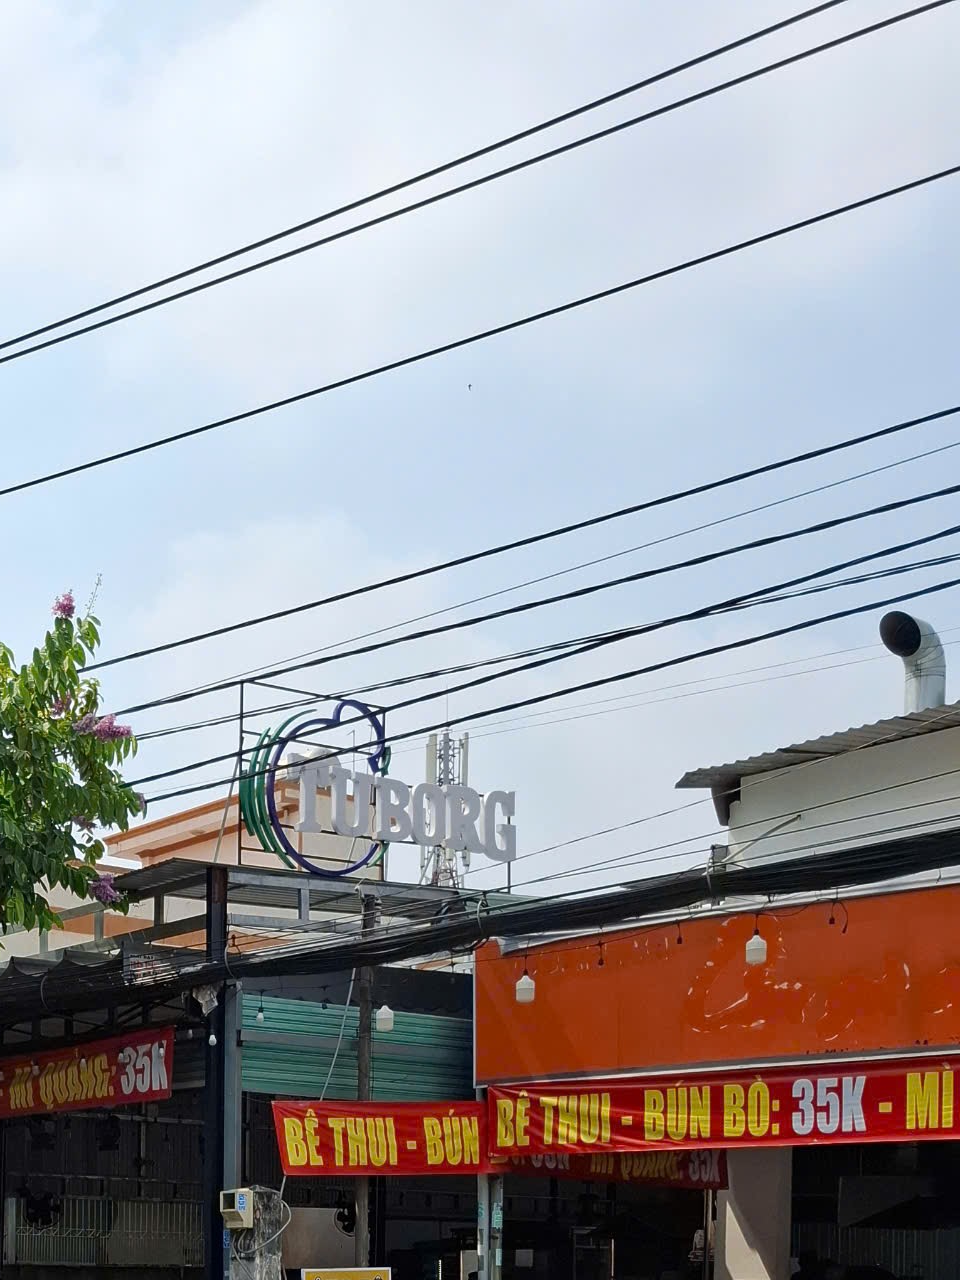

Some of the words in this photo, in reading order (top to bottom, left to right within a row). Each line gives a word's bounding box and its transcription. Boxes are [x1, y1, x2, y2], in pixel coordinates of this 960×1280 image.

[294, 764, 516, 862] TUBORG
[120, 1040, 168, 1095] 35K
[284, 1108, 323, 1166] BÊ
[328, 1117, 398, 1166] THUI
[423, 1108, 480, 1166] BÚN
[497, 1090, 530, 1147] BÊ
[540, 1093, 610, 1145] THUI
[644, 1080, 710, 1140] BÚN
[723, 1075, 780, 1138] BÒ:
[792, 1075, 867, 1136] 35K
[906, 1062, 954, 1129] MÌ
